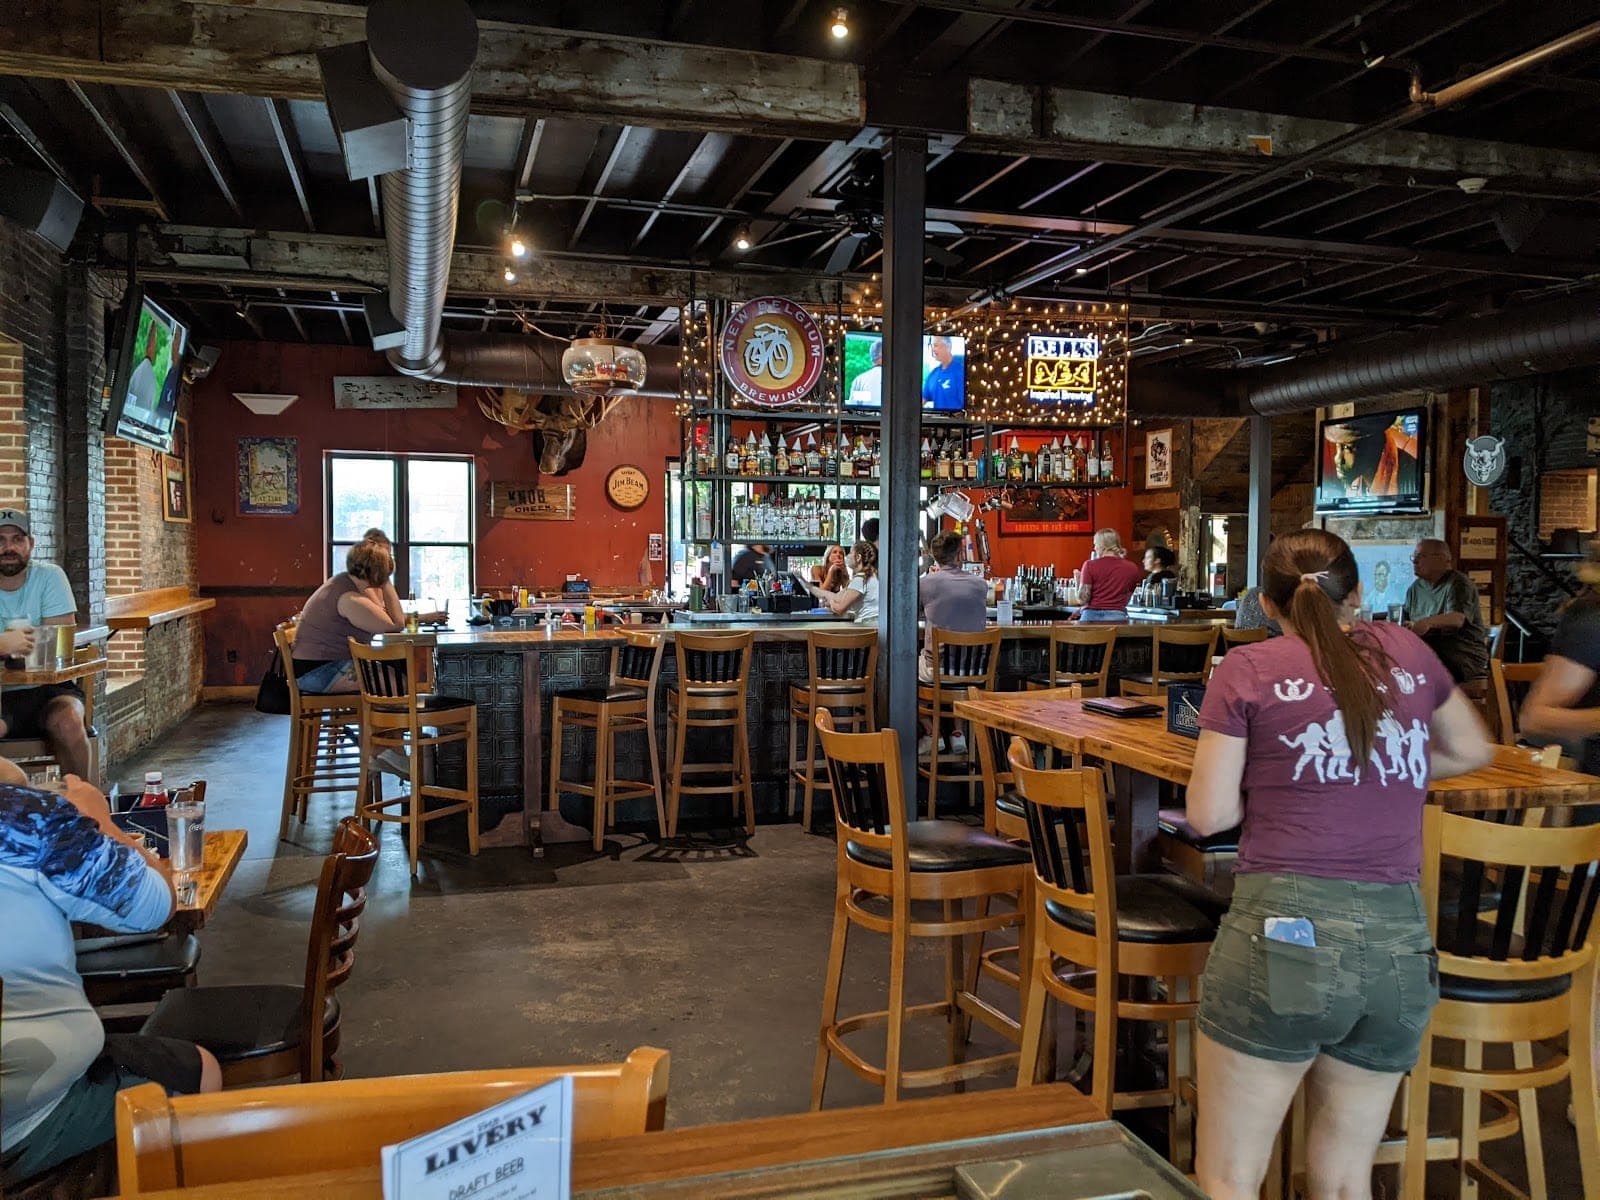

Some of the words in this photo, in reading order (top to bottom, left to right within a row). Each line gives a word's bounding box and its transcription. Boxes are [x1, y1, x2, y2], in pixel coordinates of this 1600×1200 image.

[725, 309, 749, 351] NEW
[757, 300, 821, 357] BELGIUM
[1034, 340, 1095, 358] BELL'S
[739, 382, 806, 402] BREWING
[508, 489, 546, 505] KNOB
[425, 1104, 547, 1175] LIVERY
[448, 1172, 490, 1200] DRAFT
[495, 1157, 524, 1181] BEER
